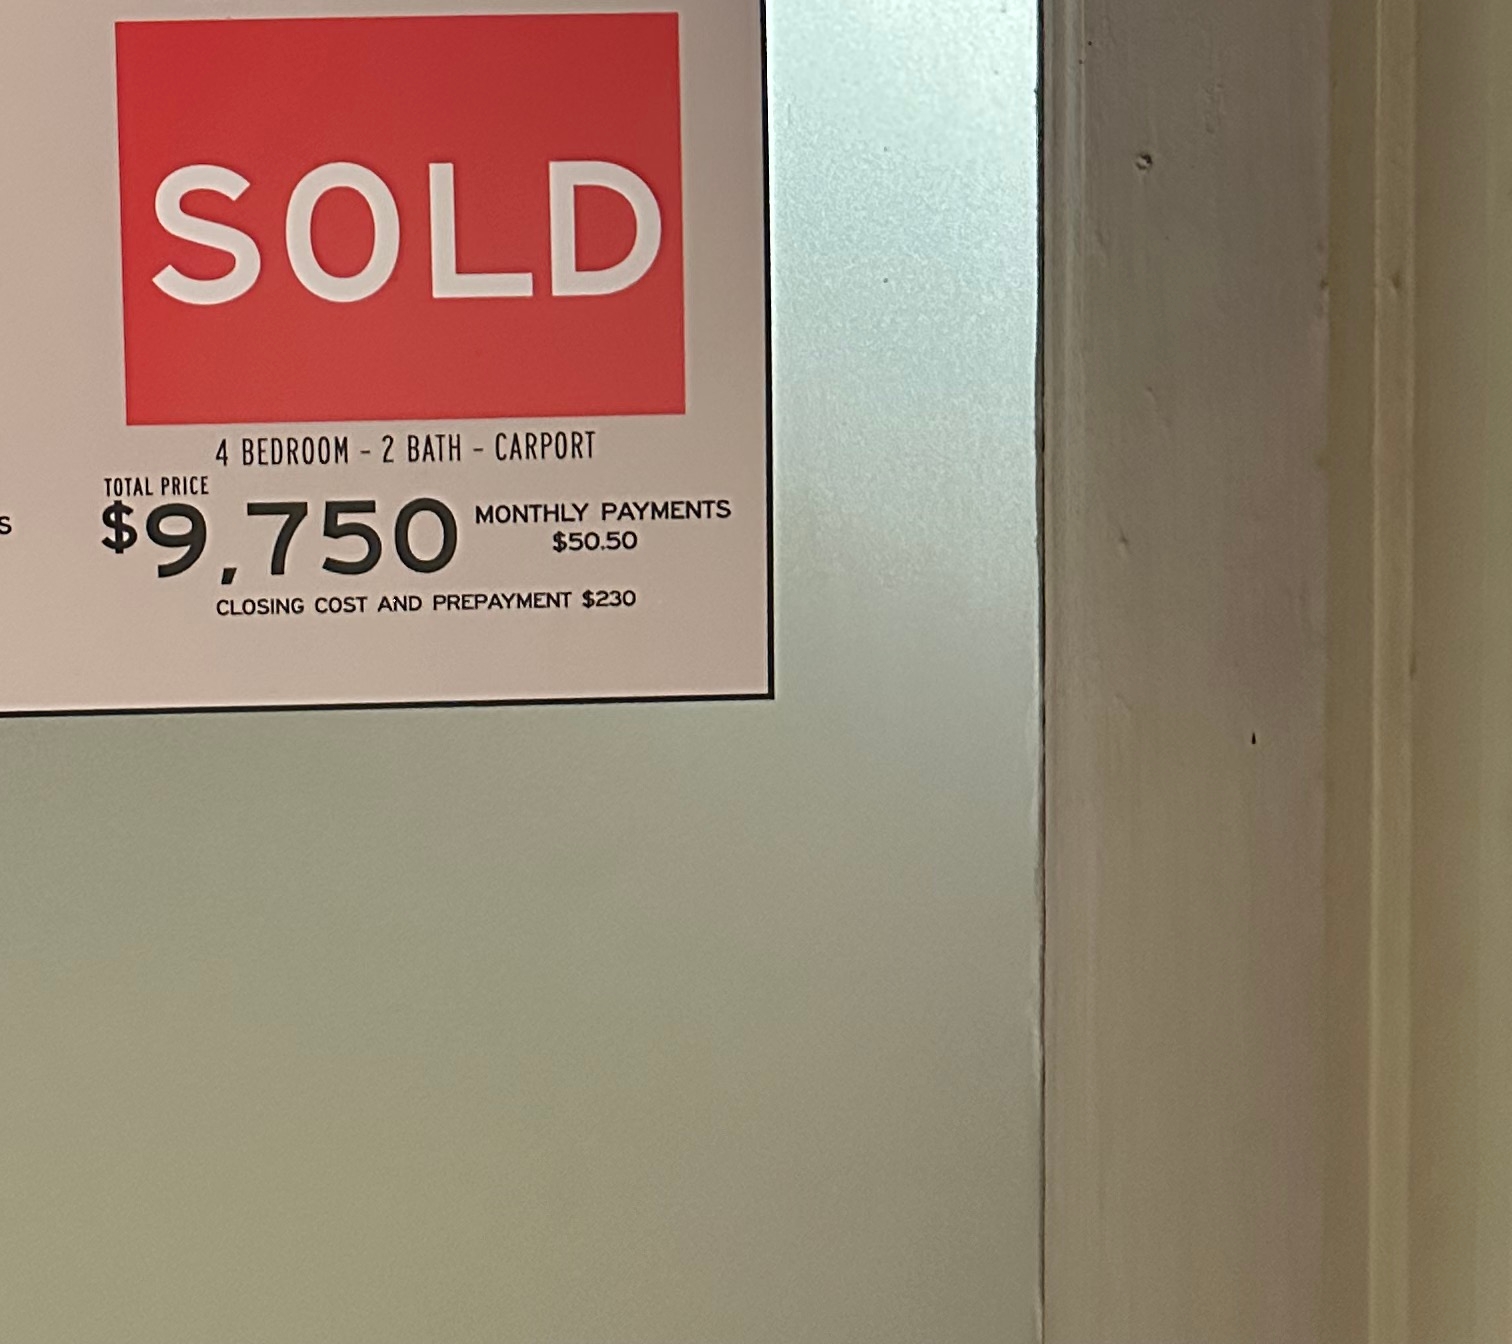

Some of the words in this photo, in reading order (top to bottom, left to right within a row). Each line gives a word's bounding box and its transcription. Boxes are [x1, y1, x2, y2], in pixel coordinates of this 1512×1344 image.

[152, 160, 662, 306] SOLD
[215, 438, 229, 467] 4
[242, 435, 349, 466] BEDROOM
[381, 434, 394, 464] 2
[407, 433, 461, 463] BATH
[495, 430, 596, 462] CARPORT
[103, 476, 154, 498] TOTAL
[160, 475, 209, 496] PRICE
[475, 502, 589, 525] MONTHLY
[601, 499, 732, 522] PAYMENTS
[101, 497, 458, 586] $9,750
[552, 530, 638, 554] $50.50
[216, 597, 305, 617] CLOSING
[314, 596, 368, 615] COST
[377, 595, 423, 613] AND
[432, 591, 573, 611] PREPAYMENT
[581, 589, 637, 609] $230
